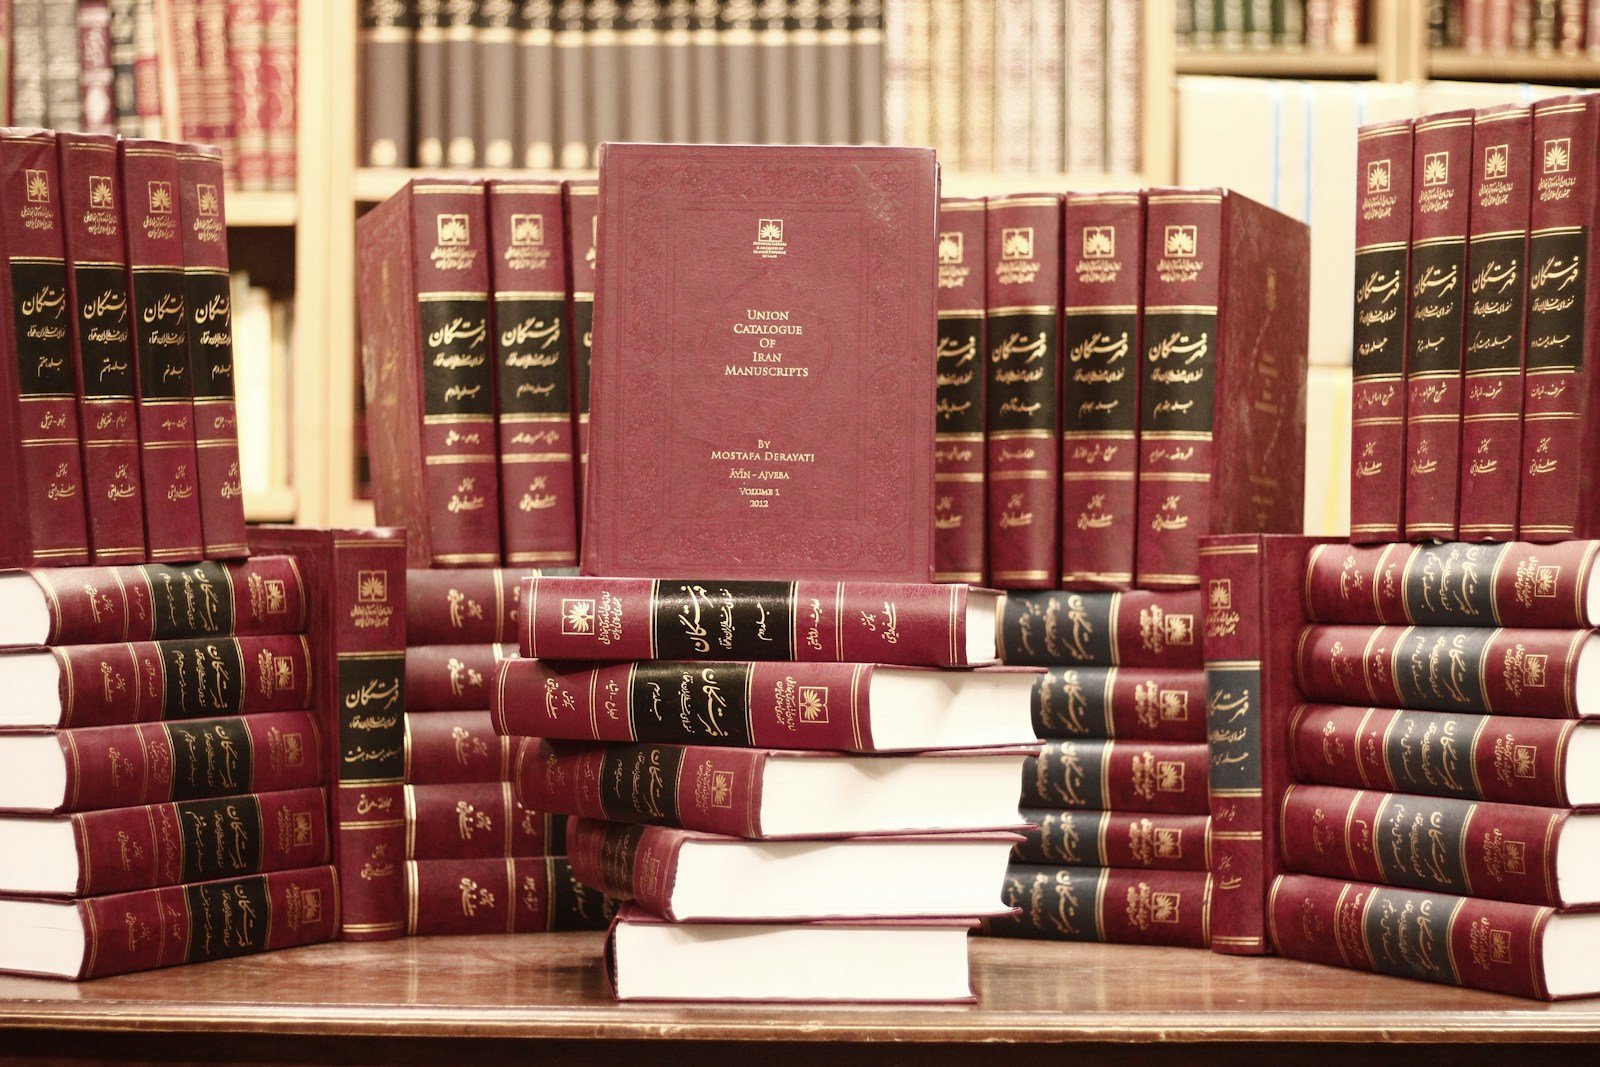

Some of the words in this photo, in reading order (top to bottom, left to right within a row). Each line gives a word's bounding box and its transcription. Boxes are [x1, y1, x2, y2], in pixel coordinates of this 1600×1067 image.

[1357, 269, 1400, 304] فهرستگان
[1414, 264, 1457, 298] فهرستگان
[1472, 259, 1516, 294] فهرستگان
[1531, 256, 1579, 291] فهرستگان
[22, 285, 65, 319] فهرستگان
[84, 289, 127, 323] فهرستگان
[144, 293, 184, 325] فهرستگان
[747, 309, 789, 320] UNION
[428, 317, 487, 350] فهرستگان
[501, 317, 560, 350] فهرستگان
[733, 323, 802, 334] CATALOGUE
[759, 338, 776, 348] OF
[753, 352, 782, 362] IRAN
[992, 332, 1047, 364] فهرستگان
[1070, 331, 1128, 363] فهرستگان
[1148, 332, 1208, 366] فهرستگان
[725, 365, 809, 377] MANUSCRIPTS
[711, 451, 761, 460] MOSTAFA
[764, 452, 815, 462] DERAYATI
[758, 439, 771, 449] BY
[739, 488, 773, 496] VOLUME
[758, 471, 790, 480] AJVEBA
[1453, 546, 1479, 615] فهرستگان
[194, 569, 218, 632] فهرستگان
[756, 602, 770, 628] جلد
[679, 585, 715, 653] فهرستگان
[757, 628, 772, 641] دوم
[207, 645, 229, 709] فهرستگان
[1442, 634, 1470, 703] فهرستگان
[345, 678, 399, 710] فهرستگان
[647, 682, 660, 695] سوم
[697, 668, 728, 737] فهرستگان
[650, 693, 662, 721] جلد
[214, 725, 238, 789] فهرستگان
[1435, 720, 1463, 790] فهرستگان
[227, 806, 248, 869] فهرستگان
[1424, 811, 1451, 884] فهرستگان
[234, 885, 256, 947] فهرستگان
[1412, 900, 1440, 970] فهرستگان
